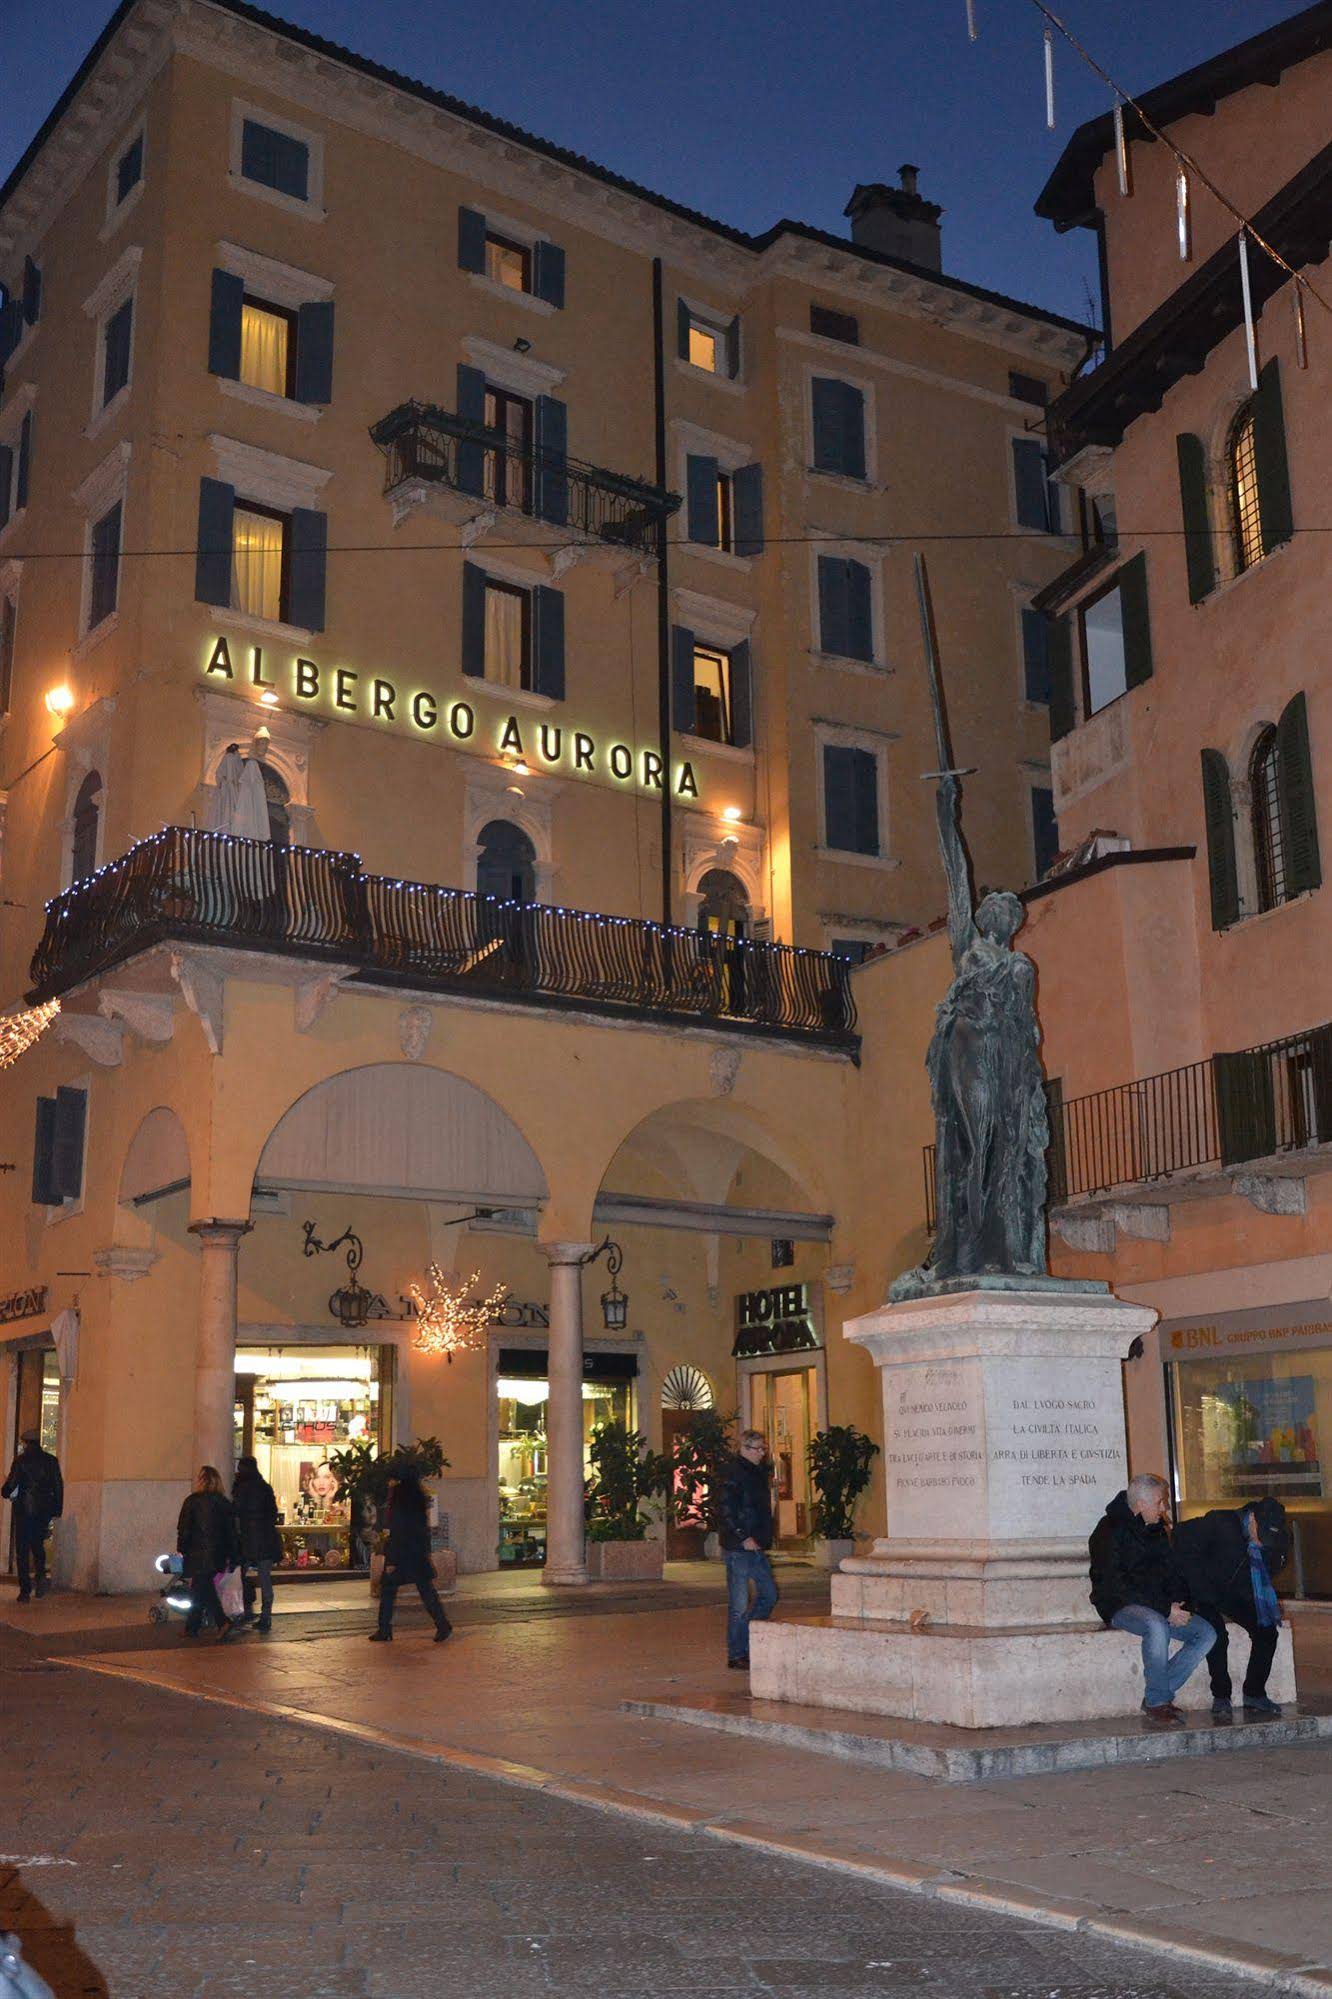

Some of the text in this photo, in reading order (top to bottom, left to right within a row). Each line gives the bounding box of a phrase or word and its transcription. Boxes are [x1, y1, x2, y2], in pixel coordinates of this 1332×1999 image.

[206, 636, 699, 798] ALBERGO AURORA
[738, 1284, 807, 1323] HOTEL
[1187, 1325, 1222, 1348] BNL
[1226, 1330, 1266, 1343] GRUPPO
[1268, 1327, 1290, 1340] BNP
[1013, 1400, 1028, 1409] DAL
[1067, 1400, 1096, 1409] SACRO
[1013, 1424, 1026, 1434] LA
[1065, 1424, 1098, 1434] ITALICA
[959, 1449, 982, 1460] STORIA
[1021, 1474, 1097, 1485] TENDE LA SPADA
